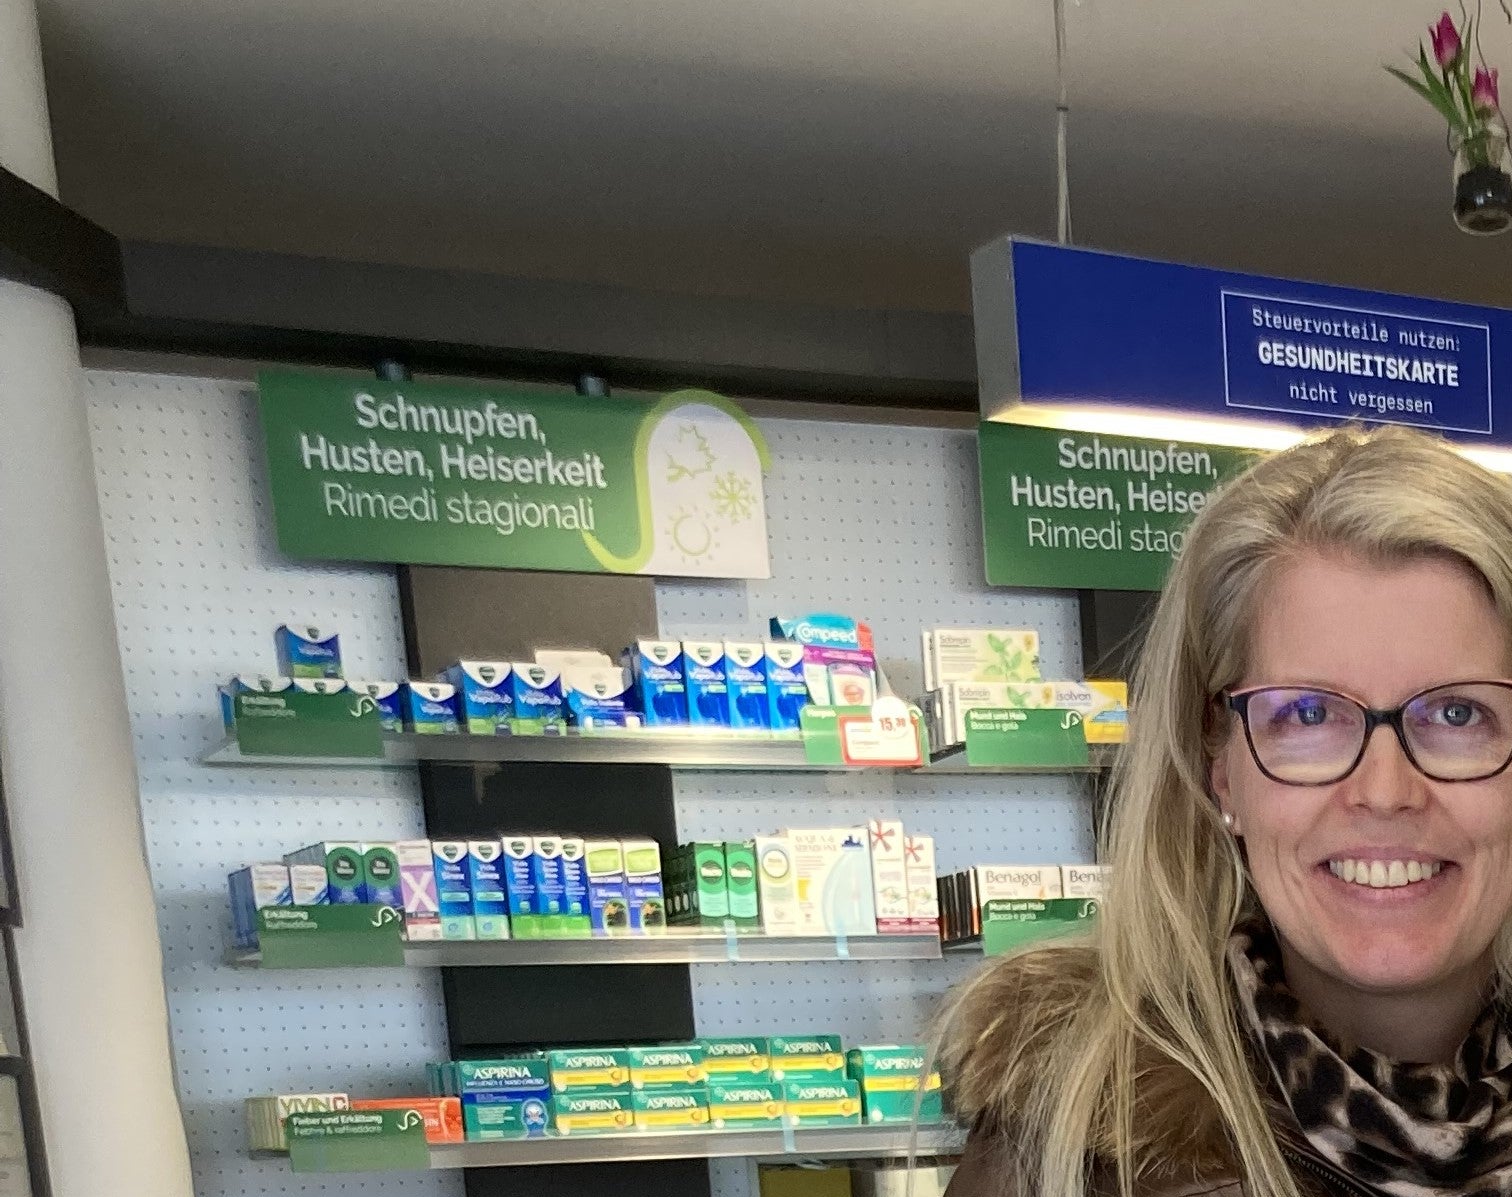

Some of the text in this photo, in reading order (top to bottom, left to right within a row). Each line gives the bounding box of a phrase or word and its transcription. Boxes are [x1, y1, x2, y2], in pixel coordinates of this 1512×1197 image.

[1252, 307, 1462, 352] Steuervorteile nutzen:
[1258, 341, 1459, 387] GESUNDHEITSKARTE
[1289, 381, 1435, 415] nicht vergessen
[354, 392, 546, 446] Schnupfen,
[300, 434, 608, 489] Husten, Heiserkeit
[1058, 438, 1218, 480] Schnupfen,
[1010, 476, 1121, 516] Husten,
[323, 482, 596, 536] Rimedi stagionali
[1028, 518, 1184, 556] Rimedi stag
[797, 622, 857, 643] Compeed
[985, 870, 1042, 886] Benagol
[708, 1042, 758, 1055] ASPIRINA
[783, 1042, 833, 1055] ASPIRINA
[565, 1056, 617, 1069] ASPIRINA
[642, 1053, 695, 1066] ASPIRINA
[473, 1066, 531, 1080] ASPIRINA
[646, 1096, 697, 1109] ASPIRINA
[724, 1088, 773, 1101] ASPIRINA
[799, 1087, 848, 1100] ASPIRINA
[569, 1098, 621, 1112] ASPIRINA
